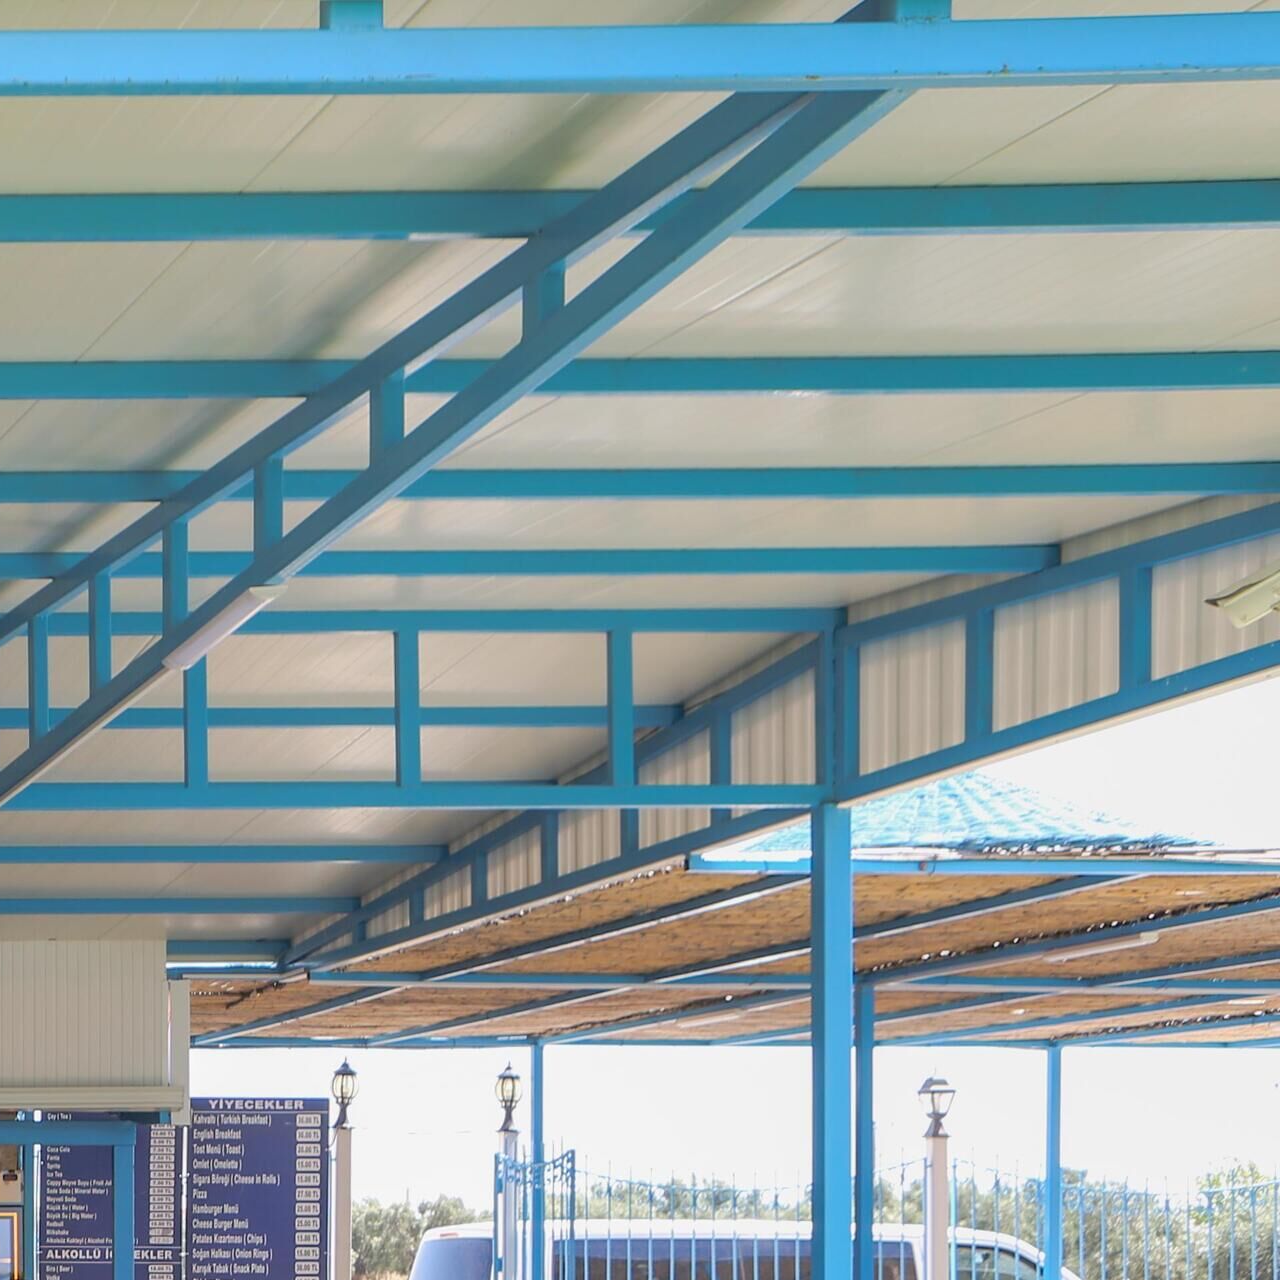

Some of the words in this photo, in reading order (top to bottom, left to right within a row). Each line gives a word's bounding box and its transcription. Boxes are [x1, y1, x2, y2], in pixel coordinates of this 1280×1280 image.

[209, 1099, 304, 1110] YİYECEKLER
[242, 1114, 268, 1124] Breakfast
[313, 1116, 319, 1125] TL
[193, 1129, 214, 1142] English
[215, 1129, 241, 1139] Breakfast
[313, 1131, 319, 1139] TL
[193, 1144, 206, 1154] Tost
[226, 1145, 241, 1154] Toast
[313, 1145, 319, 1154] TL
[193, 1159, 209, 1169] Omlet
[313, 1160, 319, 1169] TL
[193, 1174, 211, 1186] Sigara
[234, 1174, 254, 1184] Cheese
[262, 1174, 276, 1184] Rolls
[313, 1175, 319, 1183] TL
[193, 1189, 207, 1199] Pizza
[312, 1190, 318, 1198] TL
[192, 1204, 223, 1216] Hamburger
[223, 1204, 239, 1214] Menü
[312, 1204, 318, 1213] TL
[192, 1219, 212, 1229] Cheese
[213, 1219, 233, 1231] Burger
[233, 1219, 248, 1229] Menü
[312, 1219, 318, 1228] TL
[192, 1234, 212, 1243] Patates
[247, 1234, 263, 1245] Chips
[312, 1234, 318, 1243] TL
[46, 1248, 100, 1259] ALKOLLÜ
[235, 1248, 252, 1258] Onion
[253, 1248, 269, 1260] Rings
[312, 1249, 318, 1257] TL
[213, 1263, 228, 1273] Tabak
[233, 1263, 250, 1273] Snack
[251, 1263, 265, 1273] Plate
[312, 1263, 318, 1272] TL
